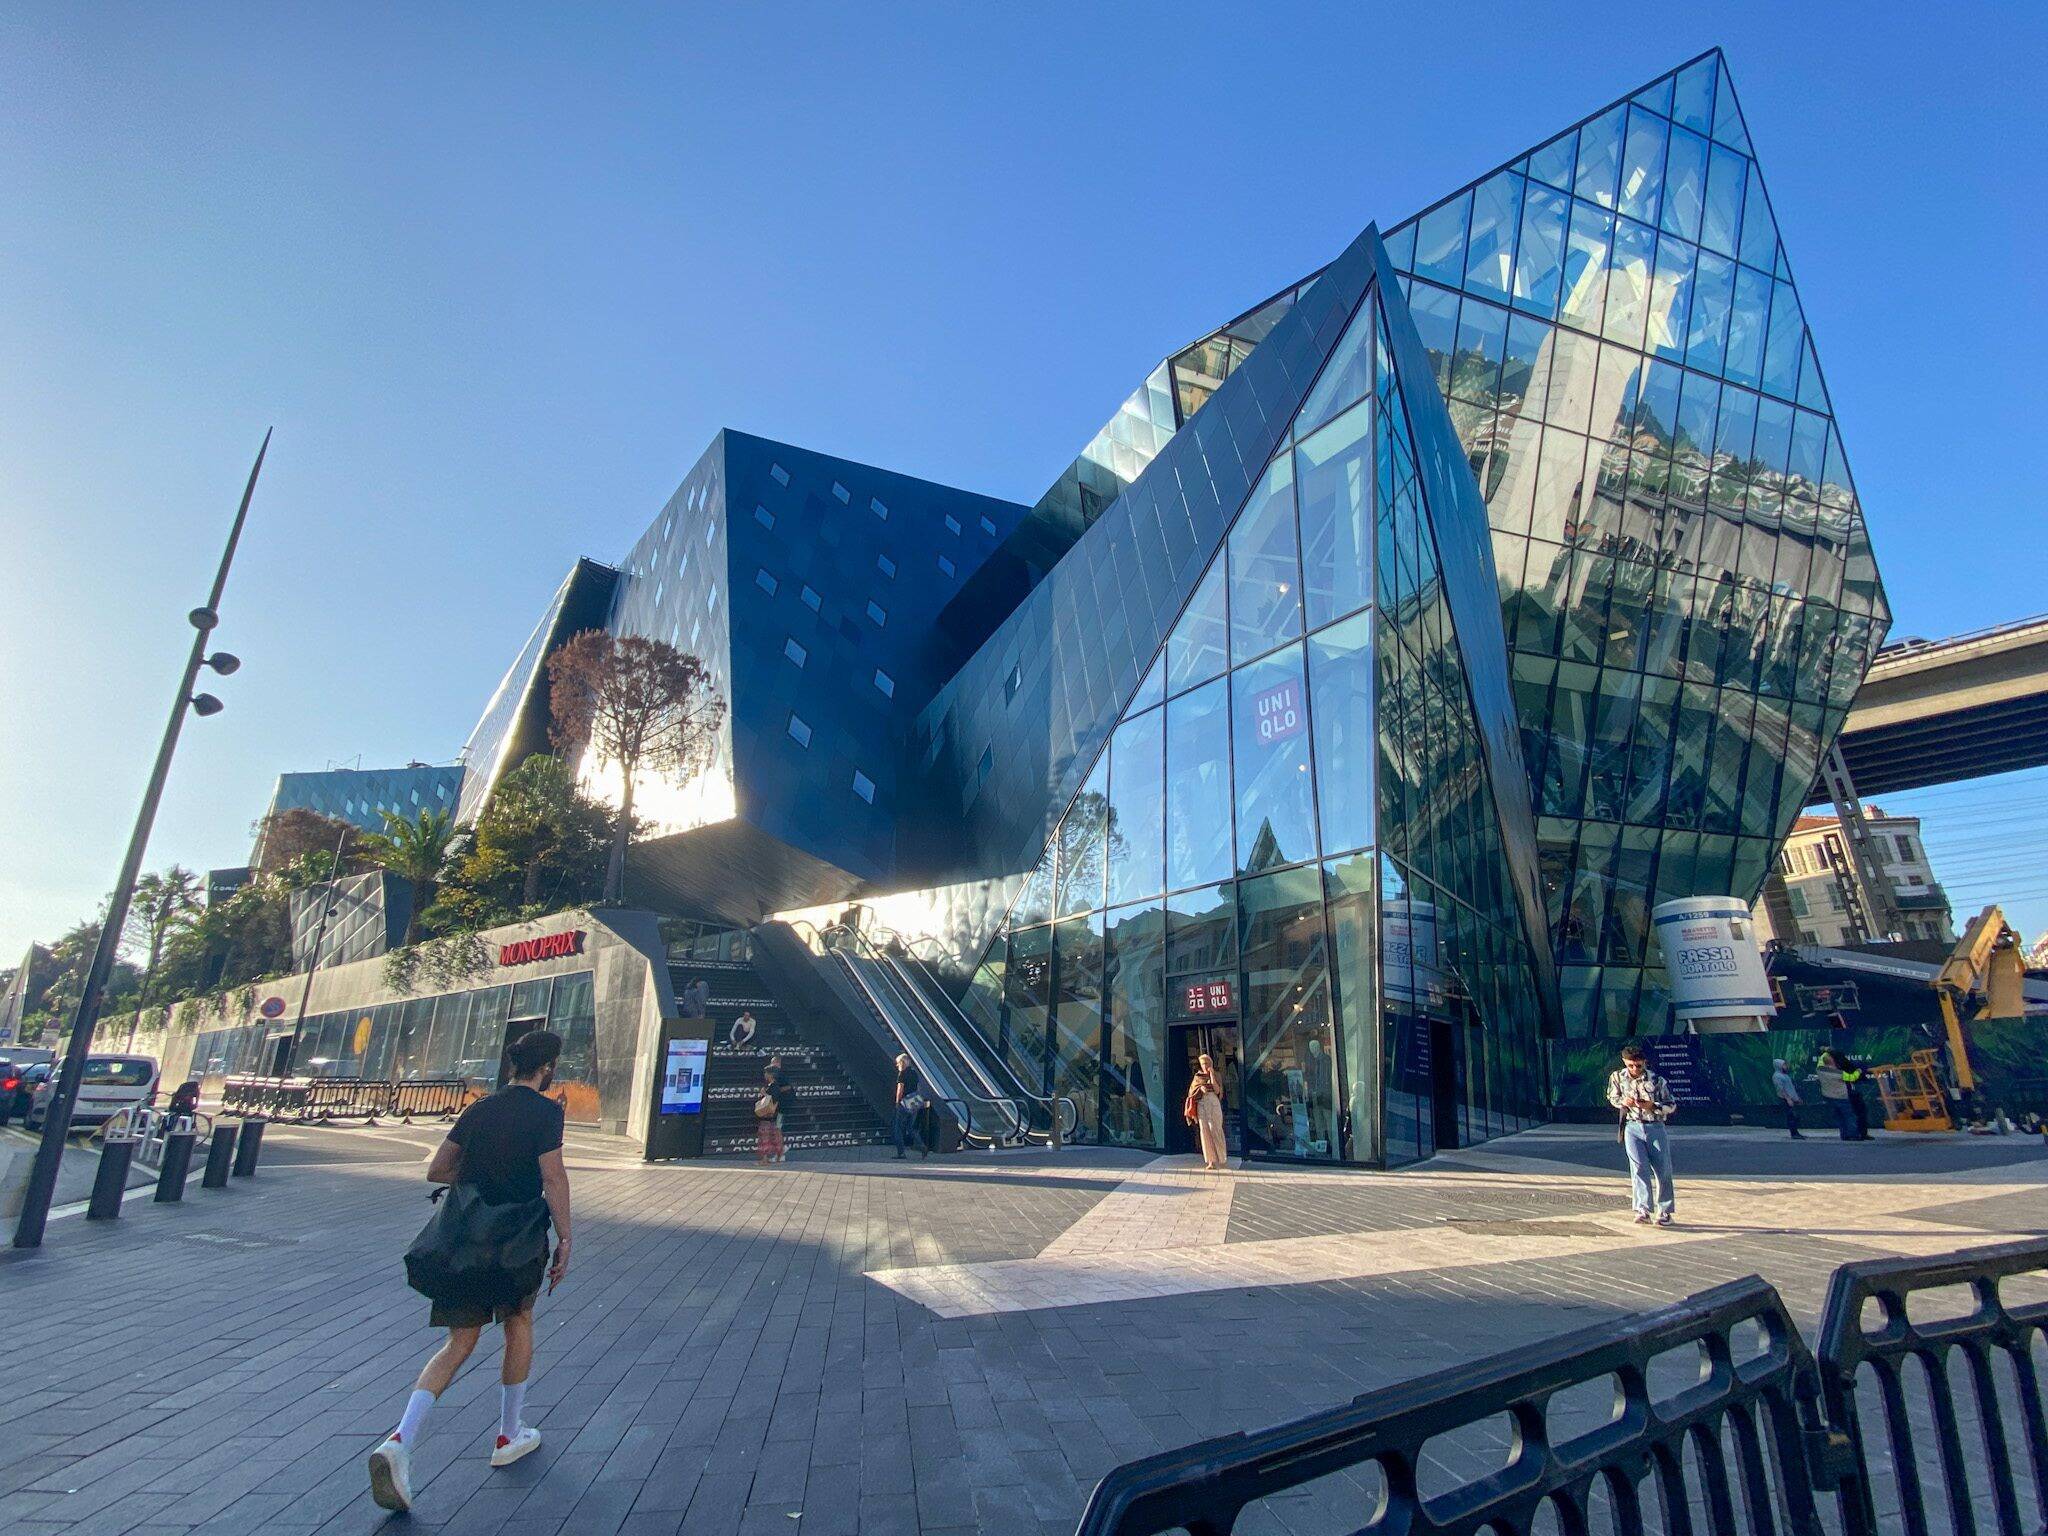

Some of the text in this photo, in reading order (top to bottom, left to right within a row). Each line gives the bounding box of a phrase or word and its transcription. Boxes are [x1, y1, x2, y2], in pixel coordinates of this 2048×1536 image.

[1258, 689, 1291, 716] UNI
[1260, 710, 1296, 738] QLO
[499, 931, 576, 965] MONOPRIX
[1678, 946, 1735, 964] FASSA
[1680, 960, 1737, 975] BORTOLO
[1210, 985, 1225, 996] UNI
[1211, 996, 1227, 1008] QLO
[797, 1085, 840, 1097] STATION
[783, 1134, 822, 1149] IRECT
[821, 1132, 859, 1146] GARE
